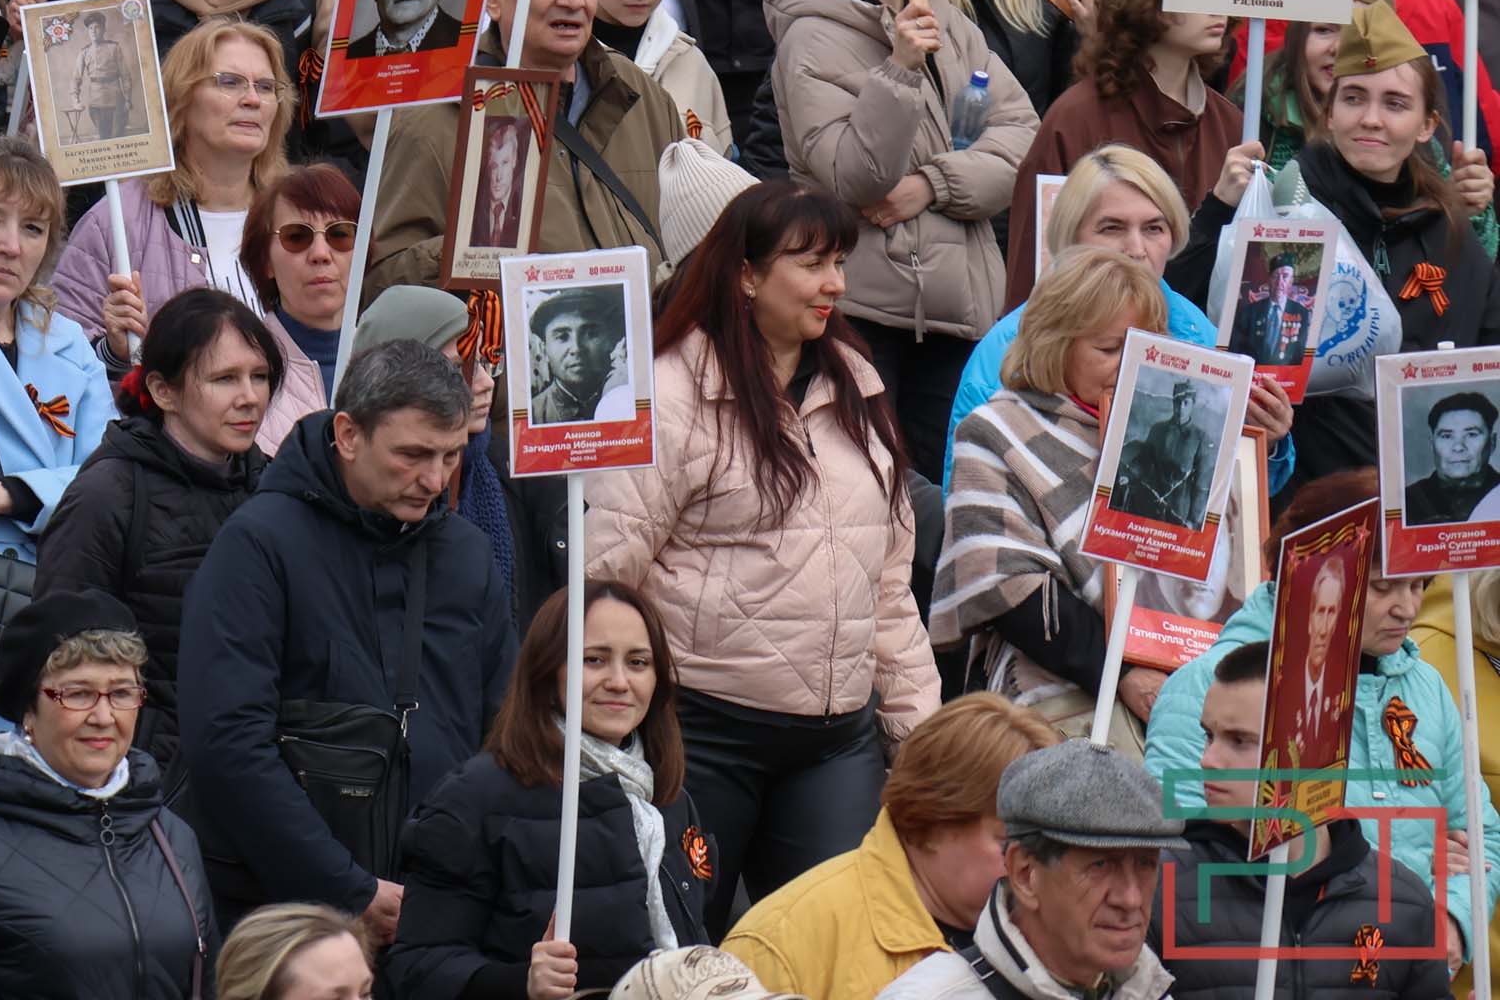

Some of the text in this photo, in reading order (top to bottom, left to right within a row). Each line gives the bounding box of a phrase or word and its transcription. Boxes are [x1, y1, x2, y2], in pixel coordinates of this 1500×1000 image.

[588, 267, 599, 277] 80
[1326, 306, 1380, 367] СУВЕНИРЫ
[1200, 363, 1210, 374] 80
[1472, 362, 1484, 373] 80
[564, 430, 602, 440] Аминов
[522, 442, 572, 454] Загидулла
[1127, 522, 1178, 541] Ахметзянов
[1438, 530, 1487, 542] Султанов
[1094, 524, 1206, 559] Мухаметхан Ахметханович
[1416, 543, 1446, 553] Гарай
[1129, 626, 1185, 646] Гатиятулла
